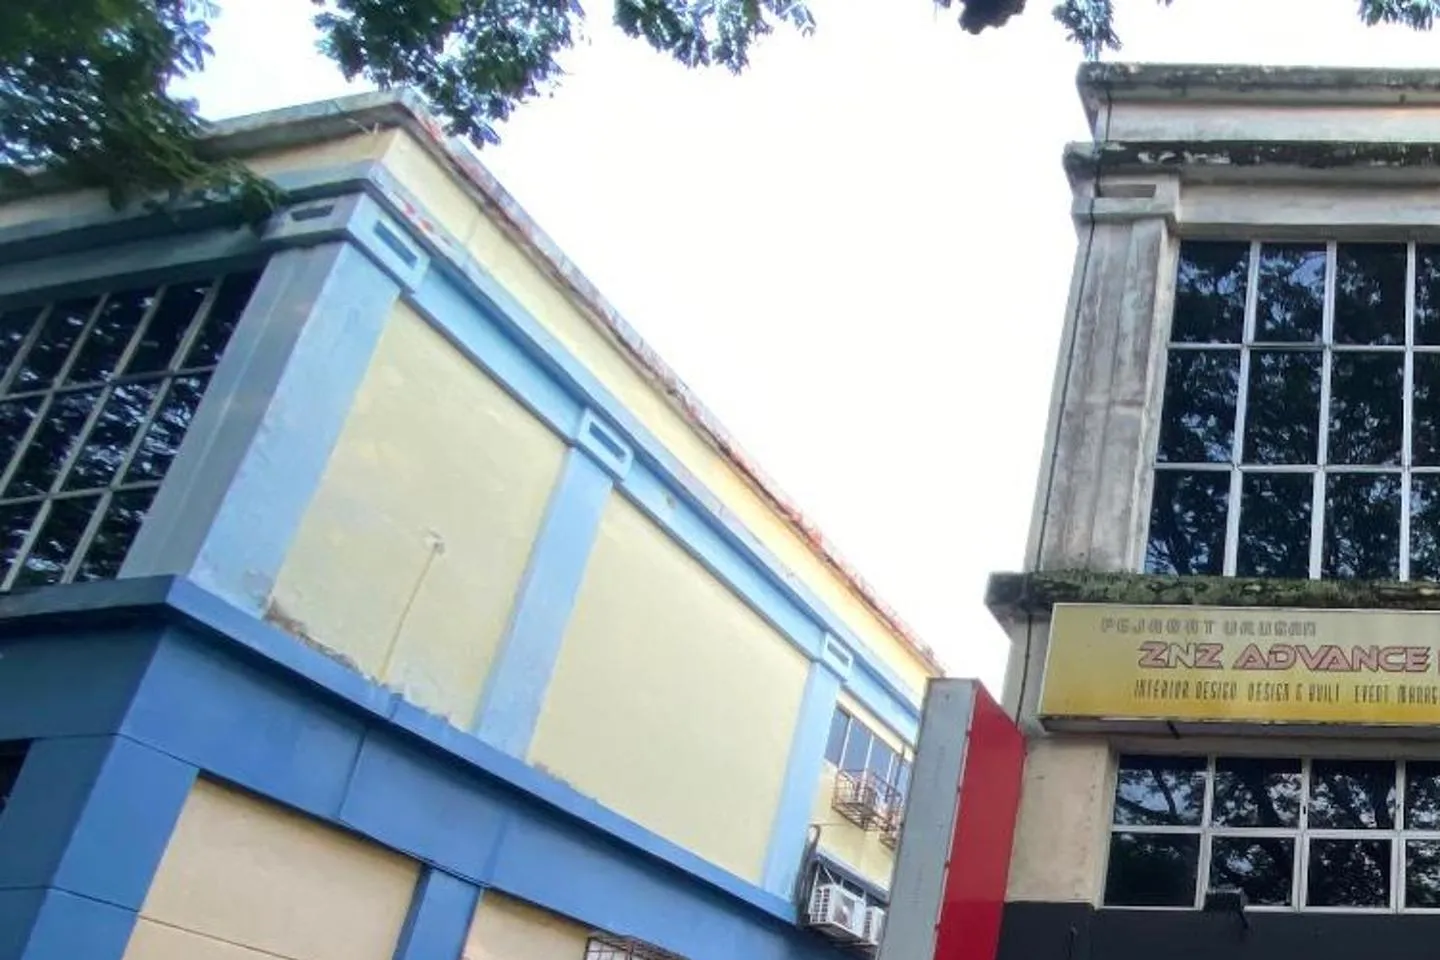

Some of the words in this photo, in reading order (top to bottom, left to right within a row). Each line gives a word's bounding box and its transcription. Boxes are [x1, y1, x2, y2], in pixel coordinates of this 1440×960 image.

[1138, 641, 1225, 670] ZNZ
[1232, 643, 1431, 673] ADVANCE
[1134, 679, 1190, 700] INTERIOR
[1195, 681, 1238, 701] DESIGN
[1247, 682, 1290, 702] DESIGN
[1354, 684, 1389, 704] EVENT
